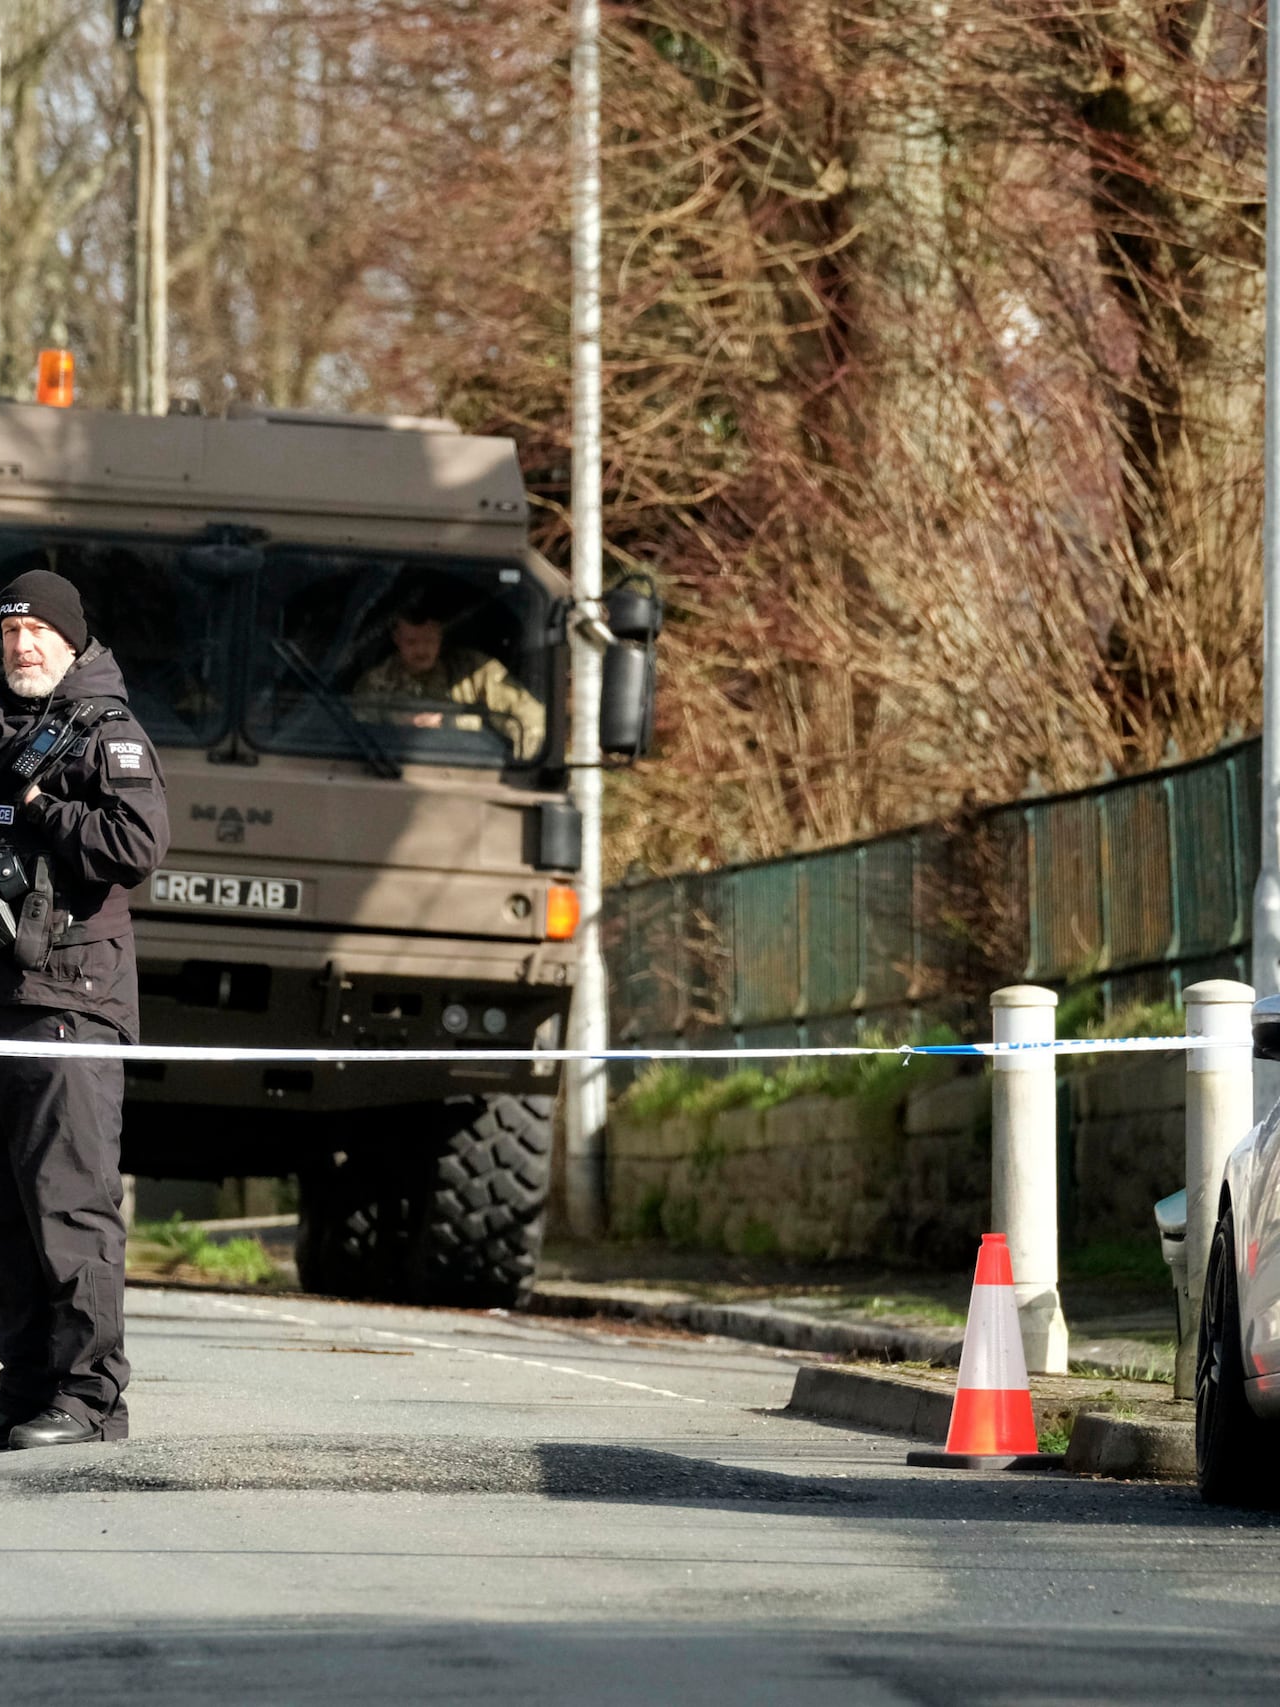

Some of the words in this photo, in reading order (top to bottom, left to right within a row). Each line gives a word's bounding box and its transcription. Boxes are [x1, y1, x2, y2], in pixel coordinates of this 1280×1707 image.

[0, 602, 30, 615] POLICE
[191, 804, 273, 826] MAN
[168, 874, 208, 905] RC
[213, 878, 241, 907] 13
[246, 880, 286, 909] AB
